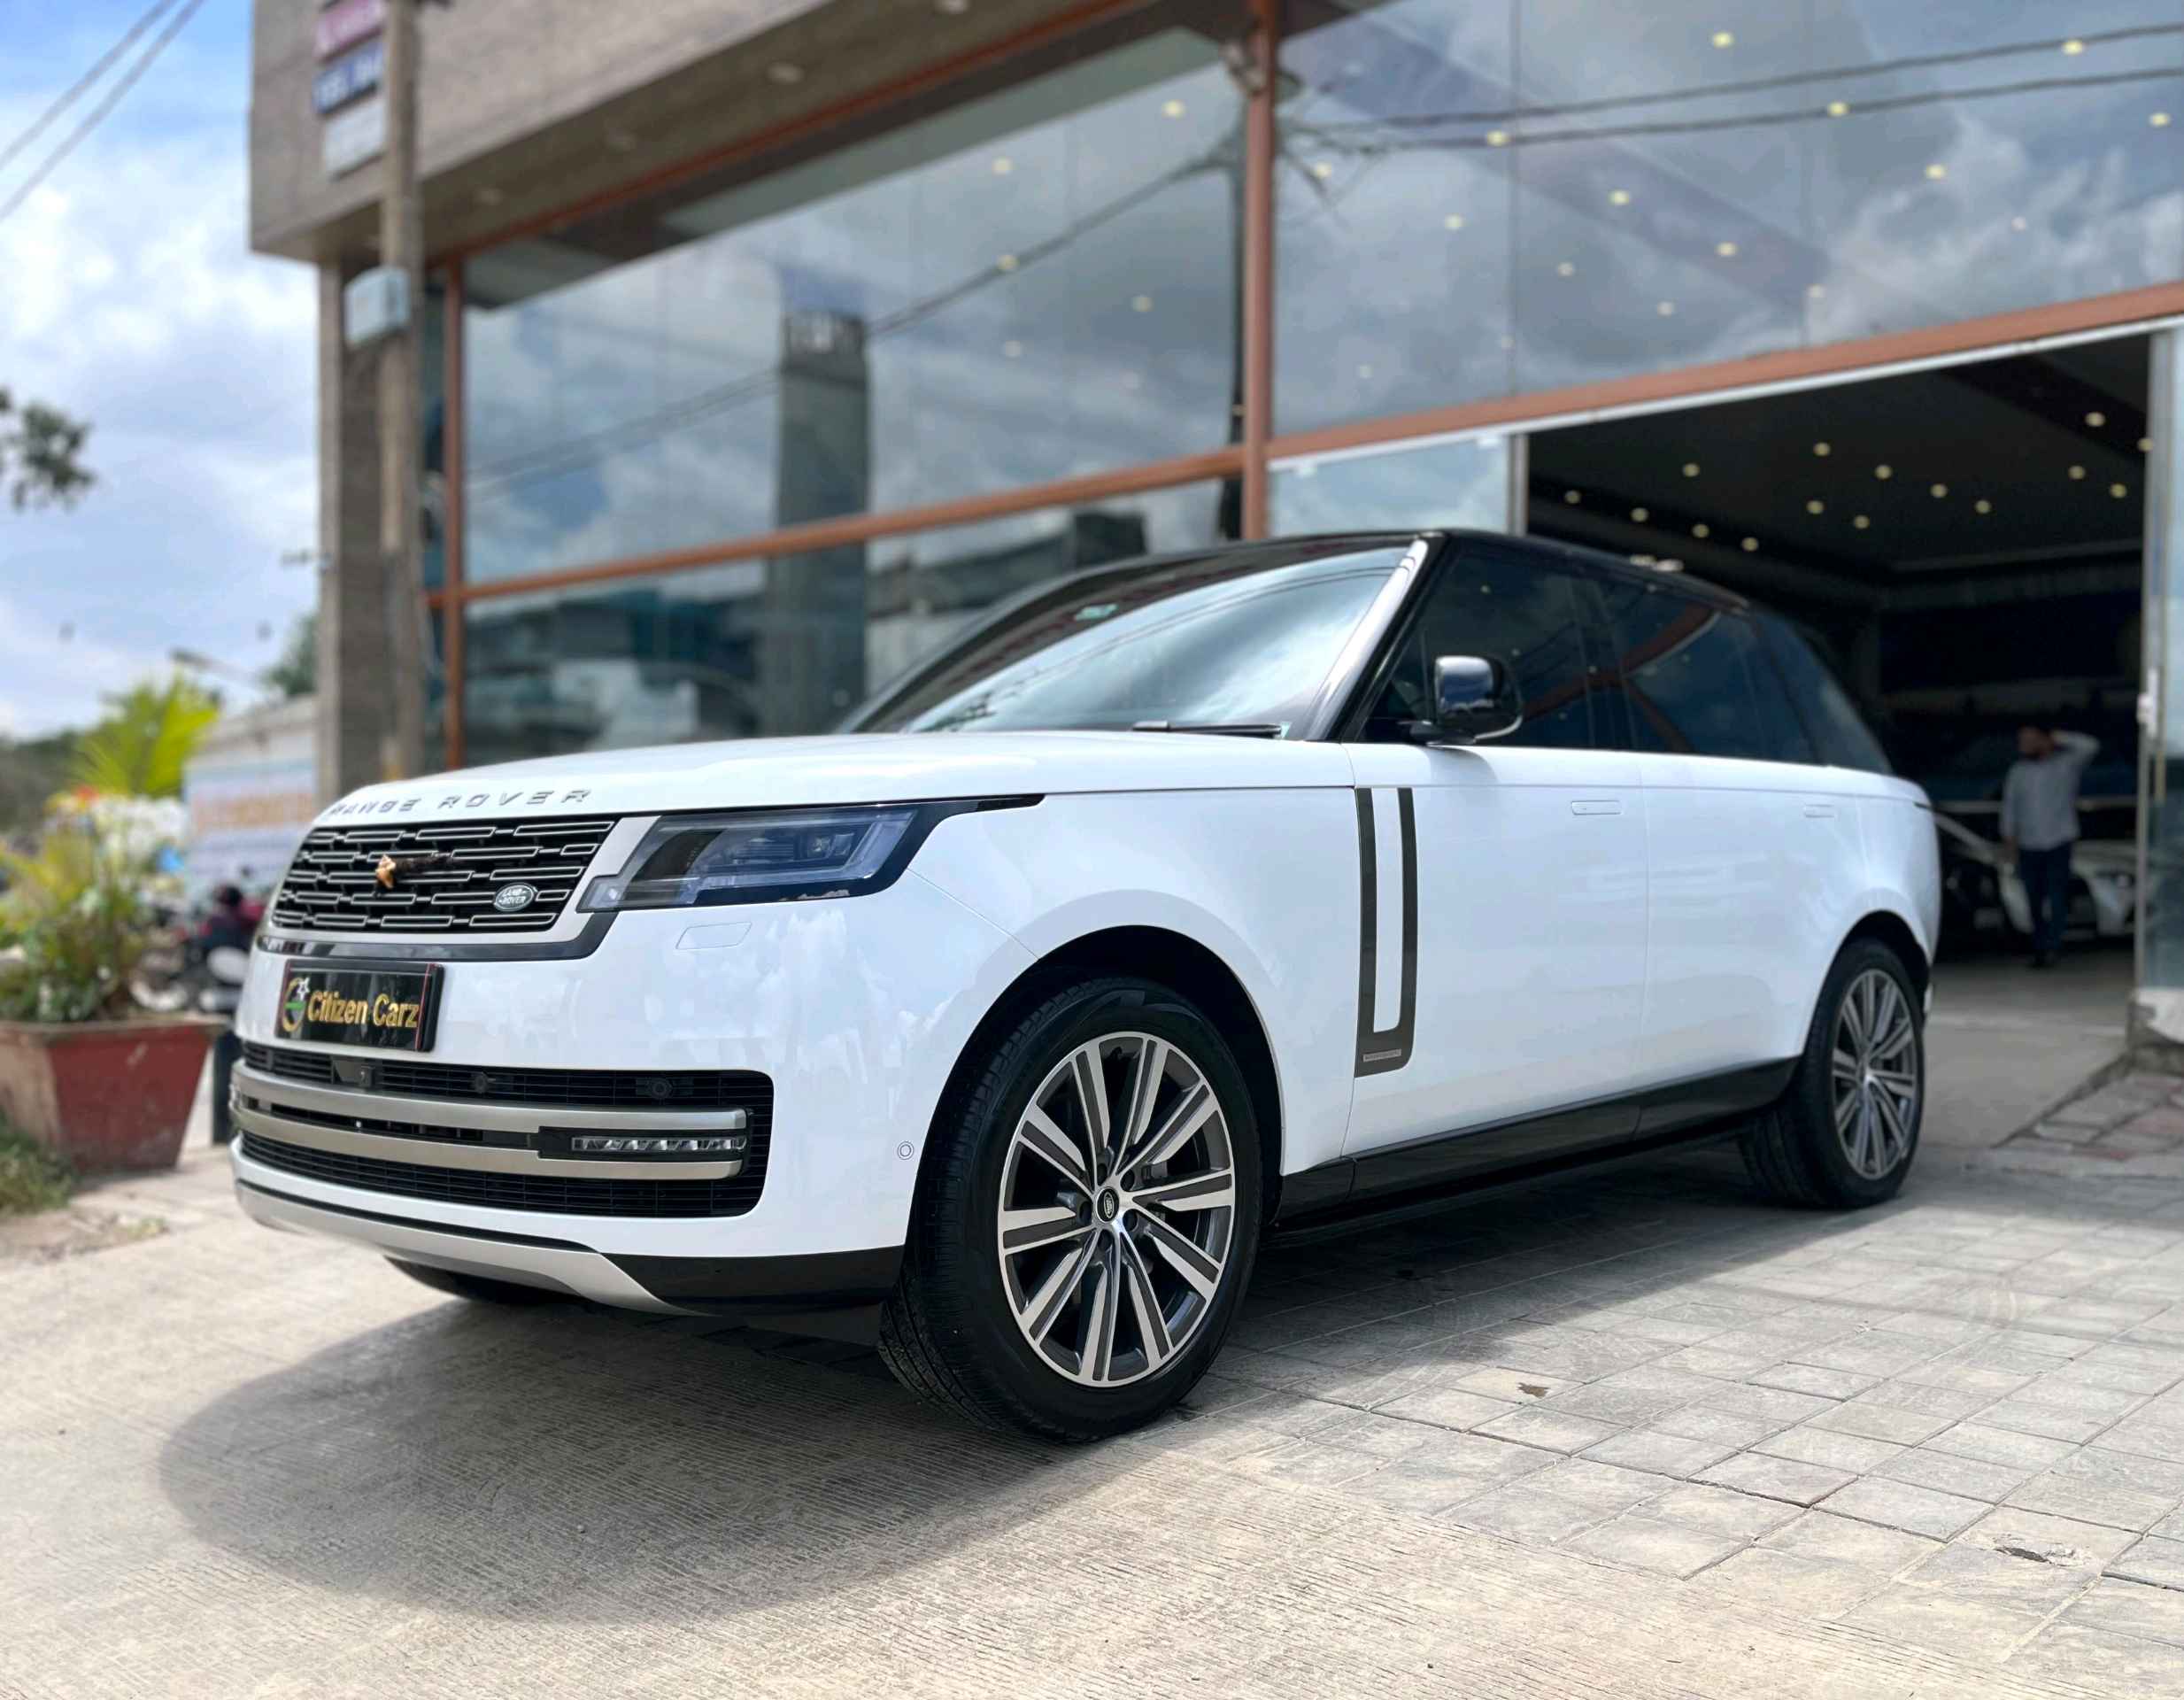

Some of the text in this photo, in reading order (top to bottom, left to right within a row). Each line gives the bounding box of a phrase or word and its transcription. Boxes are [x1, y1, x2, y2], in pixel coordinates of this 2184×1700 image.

[328, 798, 422, 815] RANGE
[437, 789, 591, 809] ROVER
[501, 895, 527, 905] ROVER
[307, 990, 421, 1028] Citizen Carz
